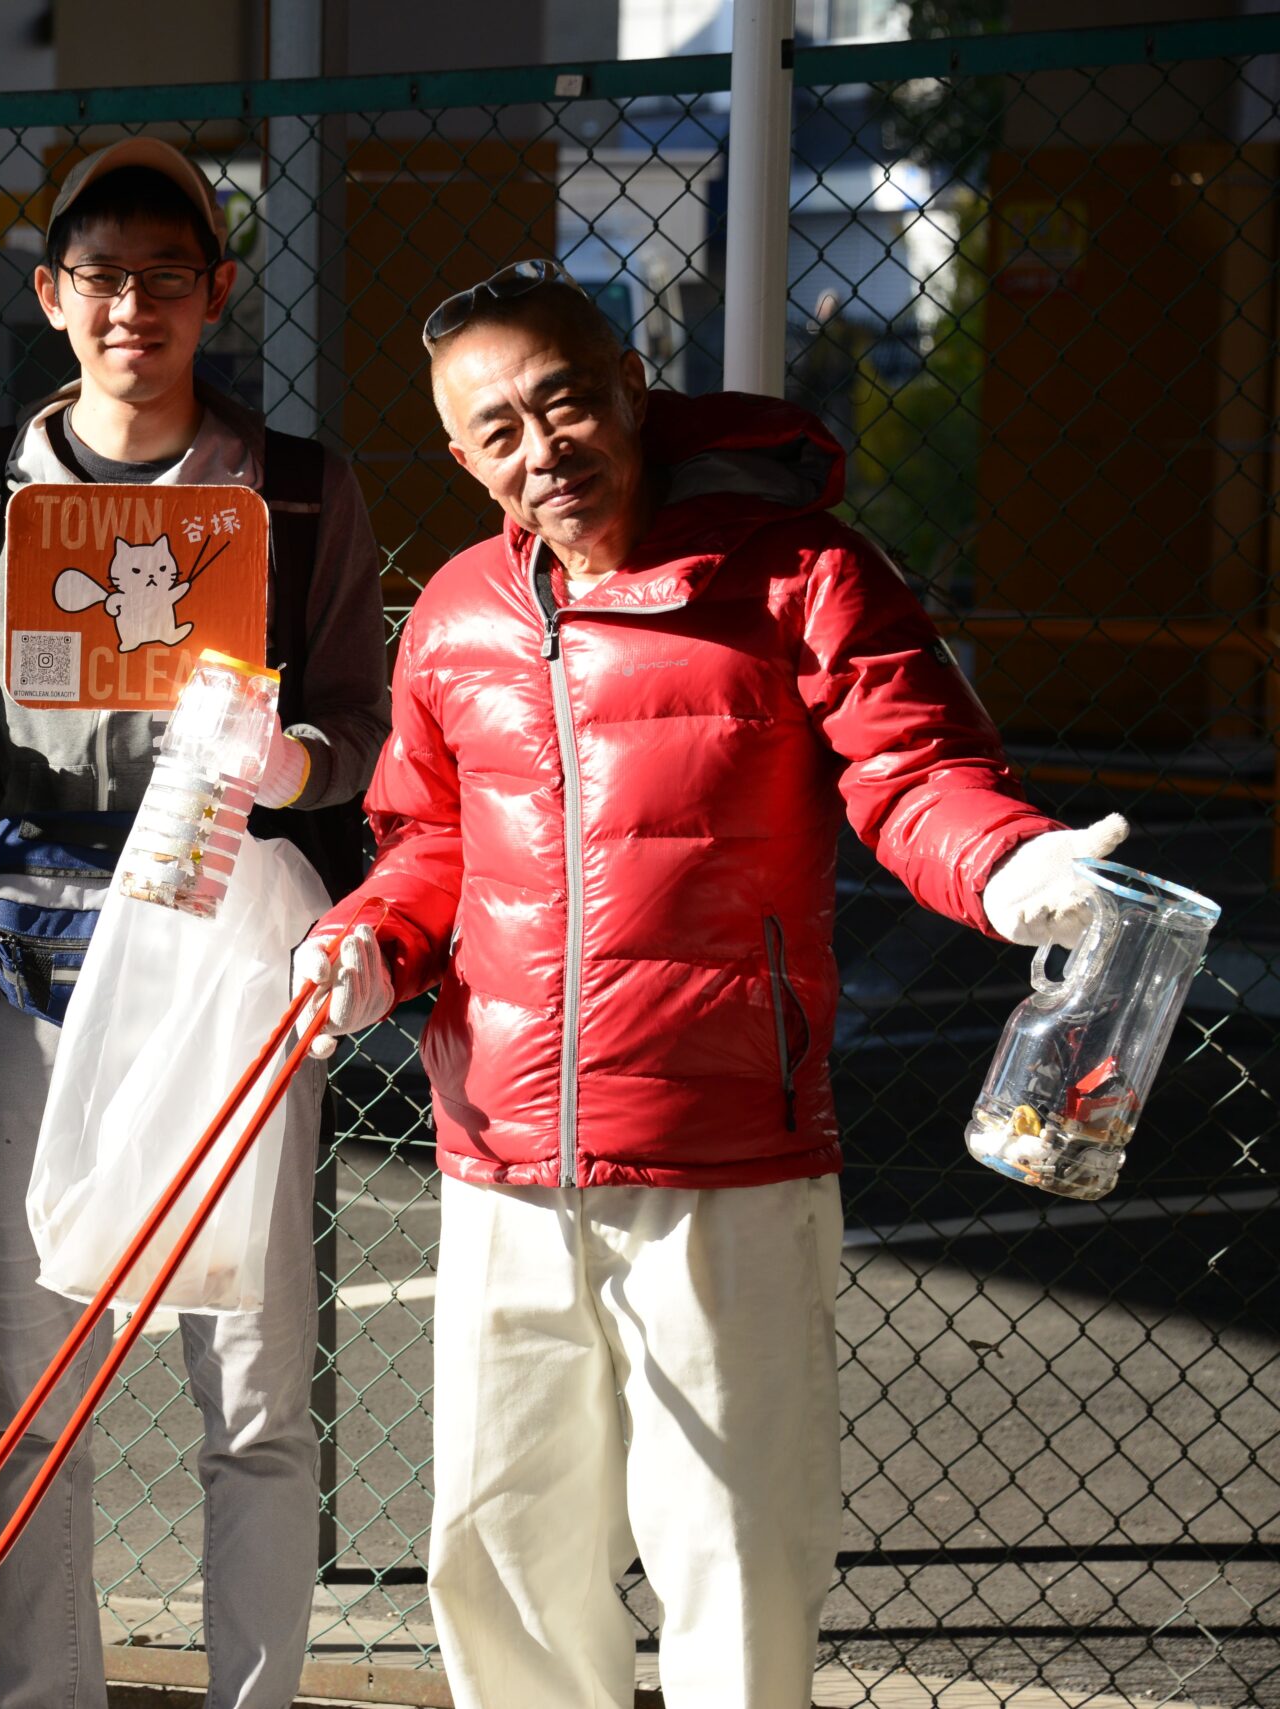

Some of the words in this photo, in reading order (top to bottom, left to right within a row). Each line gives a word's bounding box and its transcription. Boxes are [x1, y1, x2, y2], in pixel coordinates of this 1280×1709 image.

[34, 495, 163, 551] TOWN
[181, 508, 241, 543] 谷塚
[87, 646, 231, 701] CLEA
[636, 658, 689, 670] RACING
